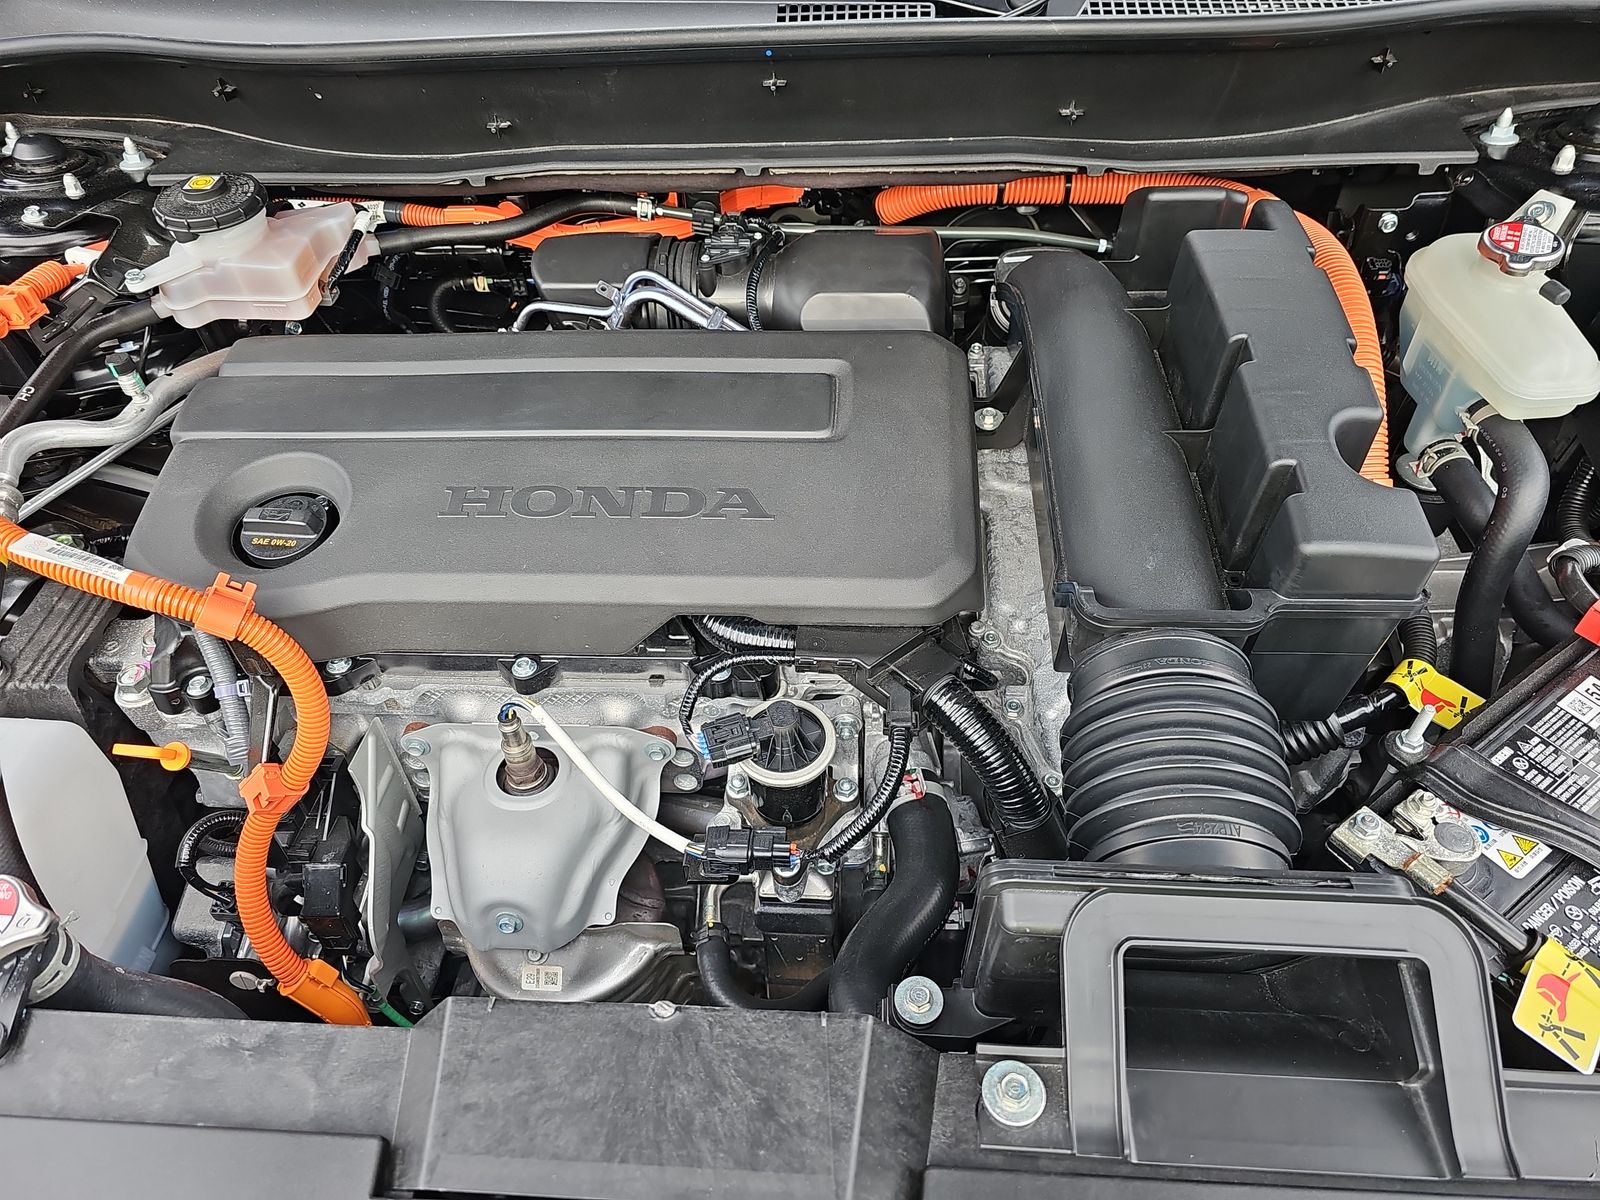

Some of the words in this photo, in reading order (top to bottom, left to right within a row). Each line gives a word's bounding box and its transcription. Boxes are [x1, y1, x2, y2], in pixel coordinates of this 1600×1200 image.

[437, 484, 775, 521] HONDA
[251, 537, 270, 546] SAE
[270, 538, 297, 547] 0W-20
